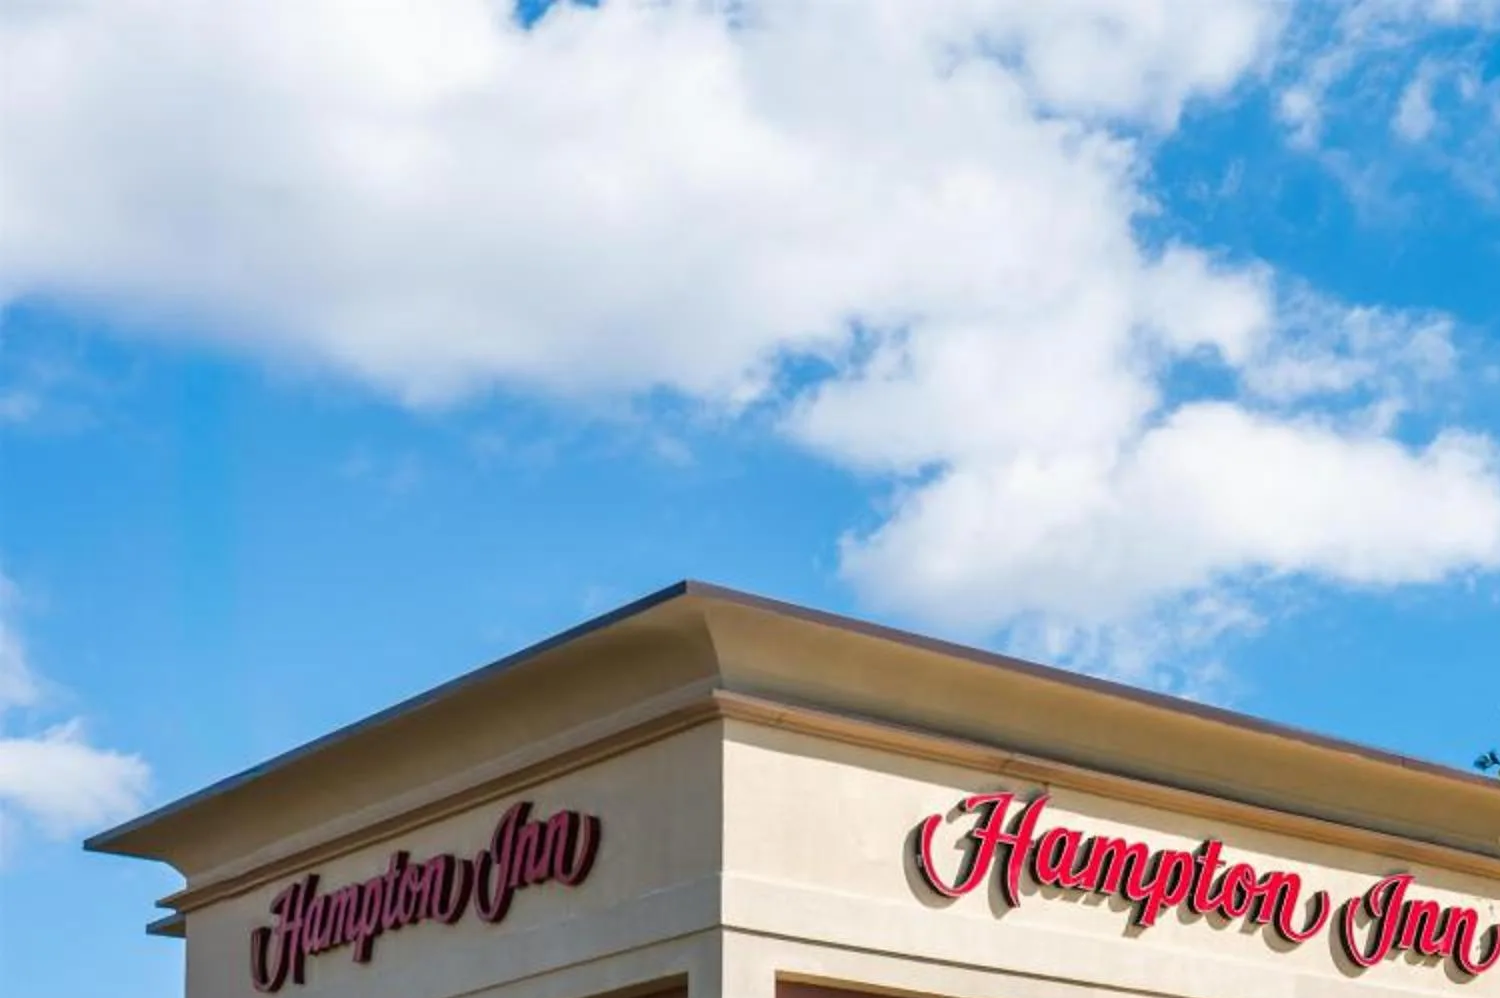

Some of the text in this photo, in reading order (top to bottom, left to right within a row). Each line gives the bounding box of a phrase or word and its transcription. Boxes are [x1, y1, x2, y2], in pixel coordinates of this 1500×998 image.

[251, 801, 601, 993] Hampton Inn
[920, 792, 1331, 942] Hampton
